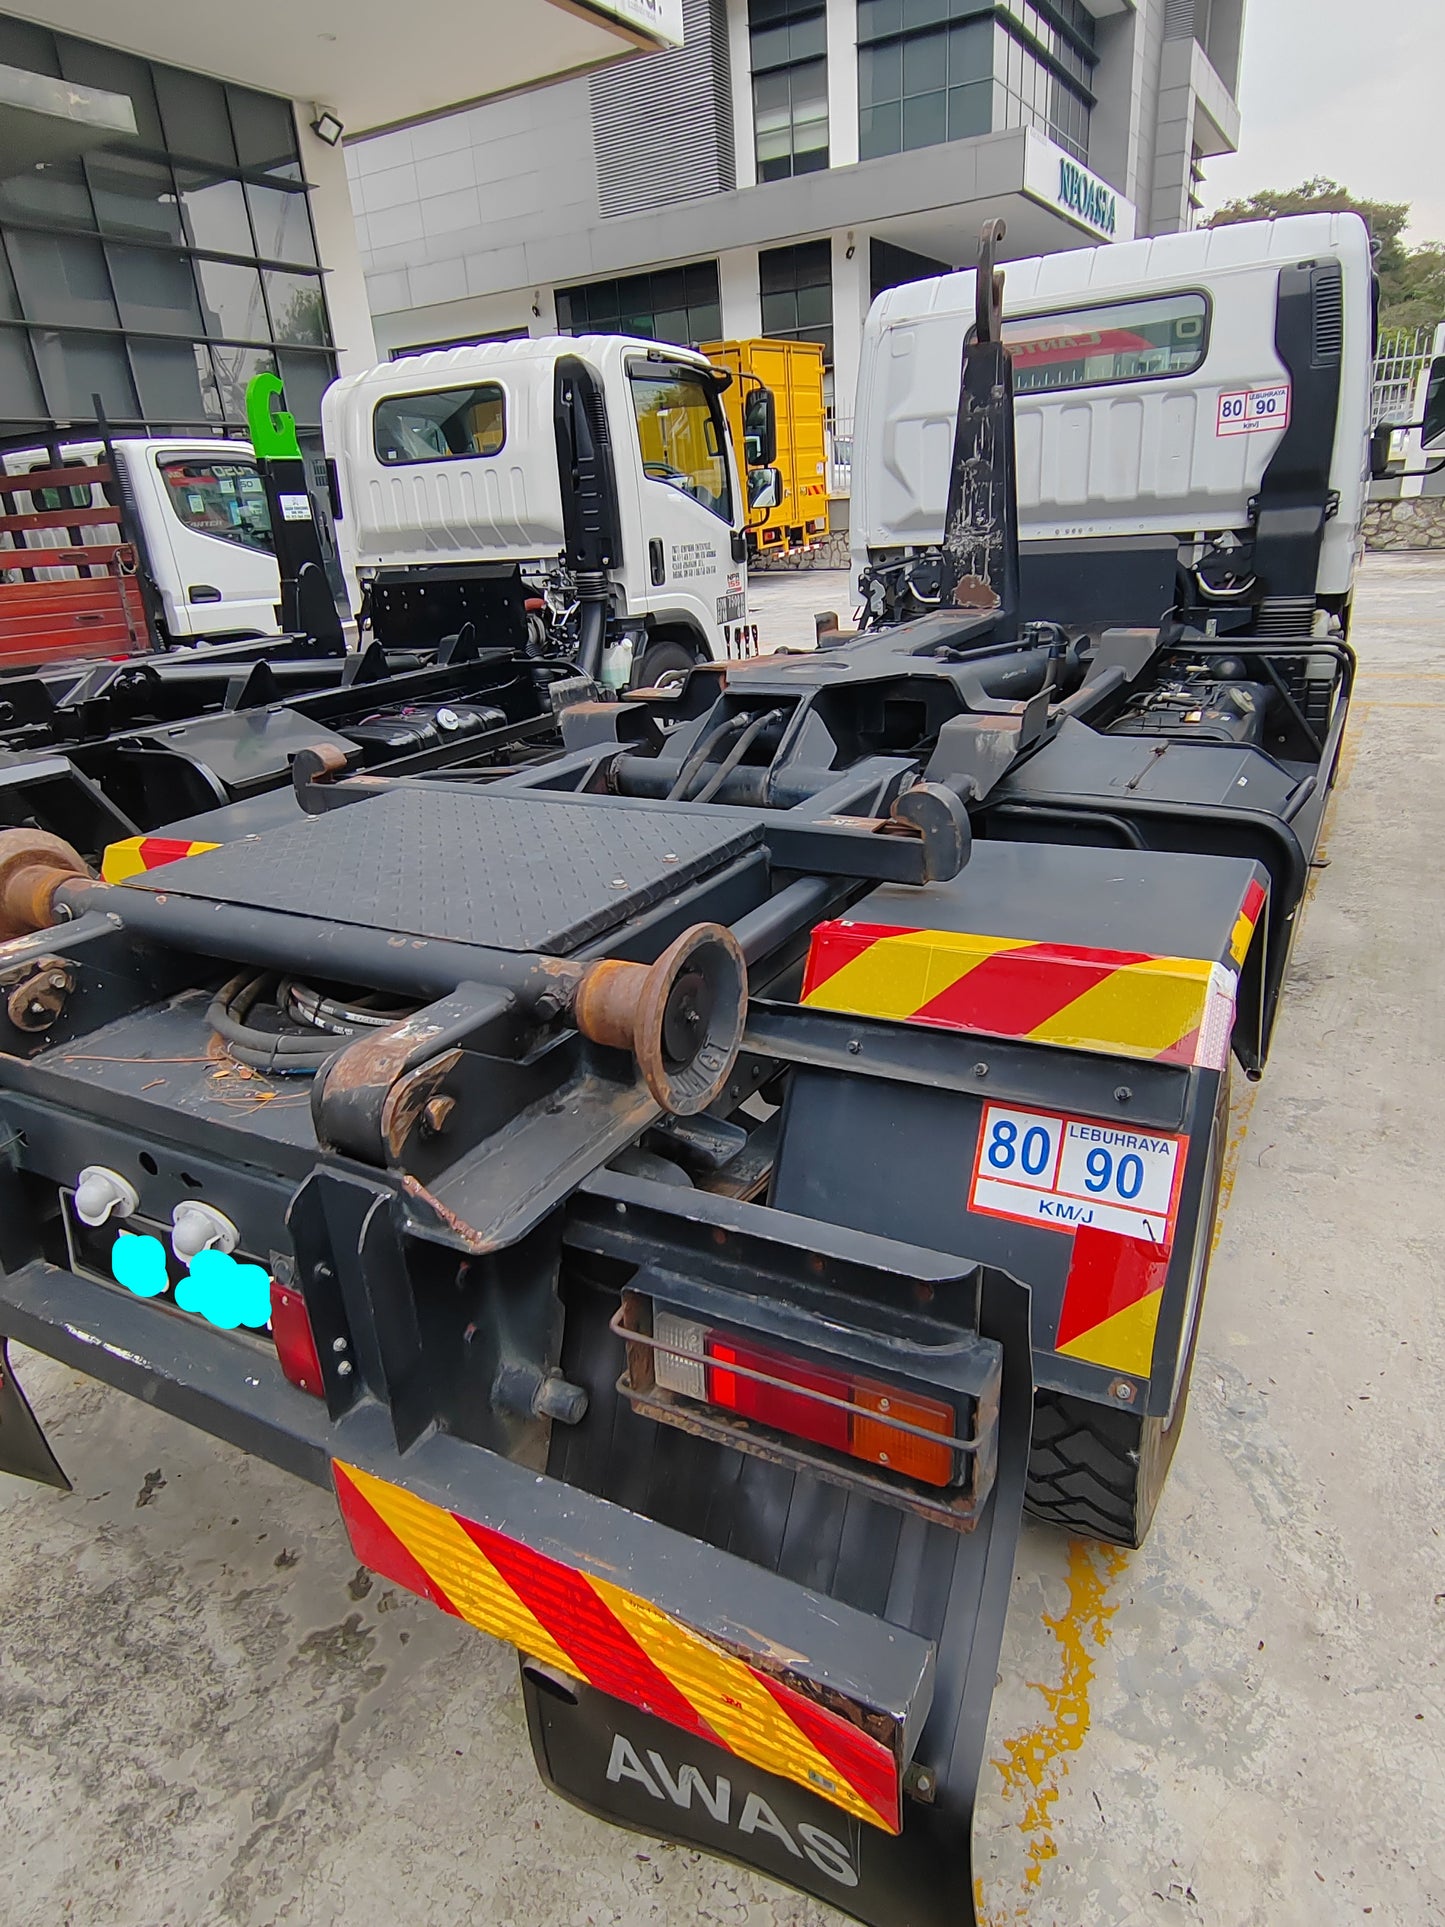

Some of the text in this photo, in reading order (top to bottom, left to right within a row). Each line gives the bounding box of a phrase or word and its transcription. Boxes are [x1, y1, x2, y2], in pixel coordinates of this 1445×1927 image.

[1222, 398, 1276, 417] 80 90
[1248, 389, 1286, 400] LEBUHRAYA
[1069, 1124, 1170, 1156] LEBUHRAYA
[988, 1120, 1144, 1199] 80 90
[1038, 1199, 1094, 1224] KM/J
[606, 1733, 859, 1887] AWAS
